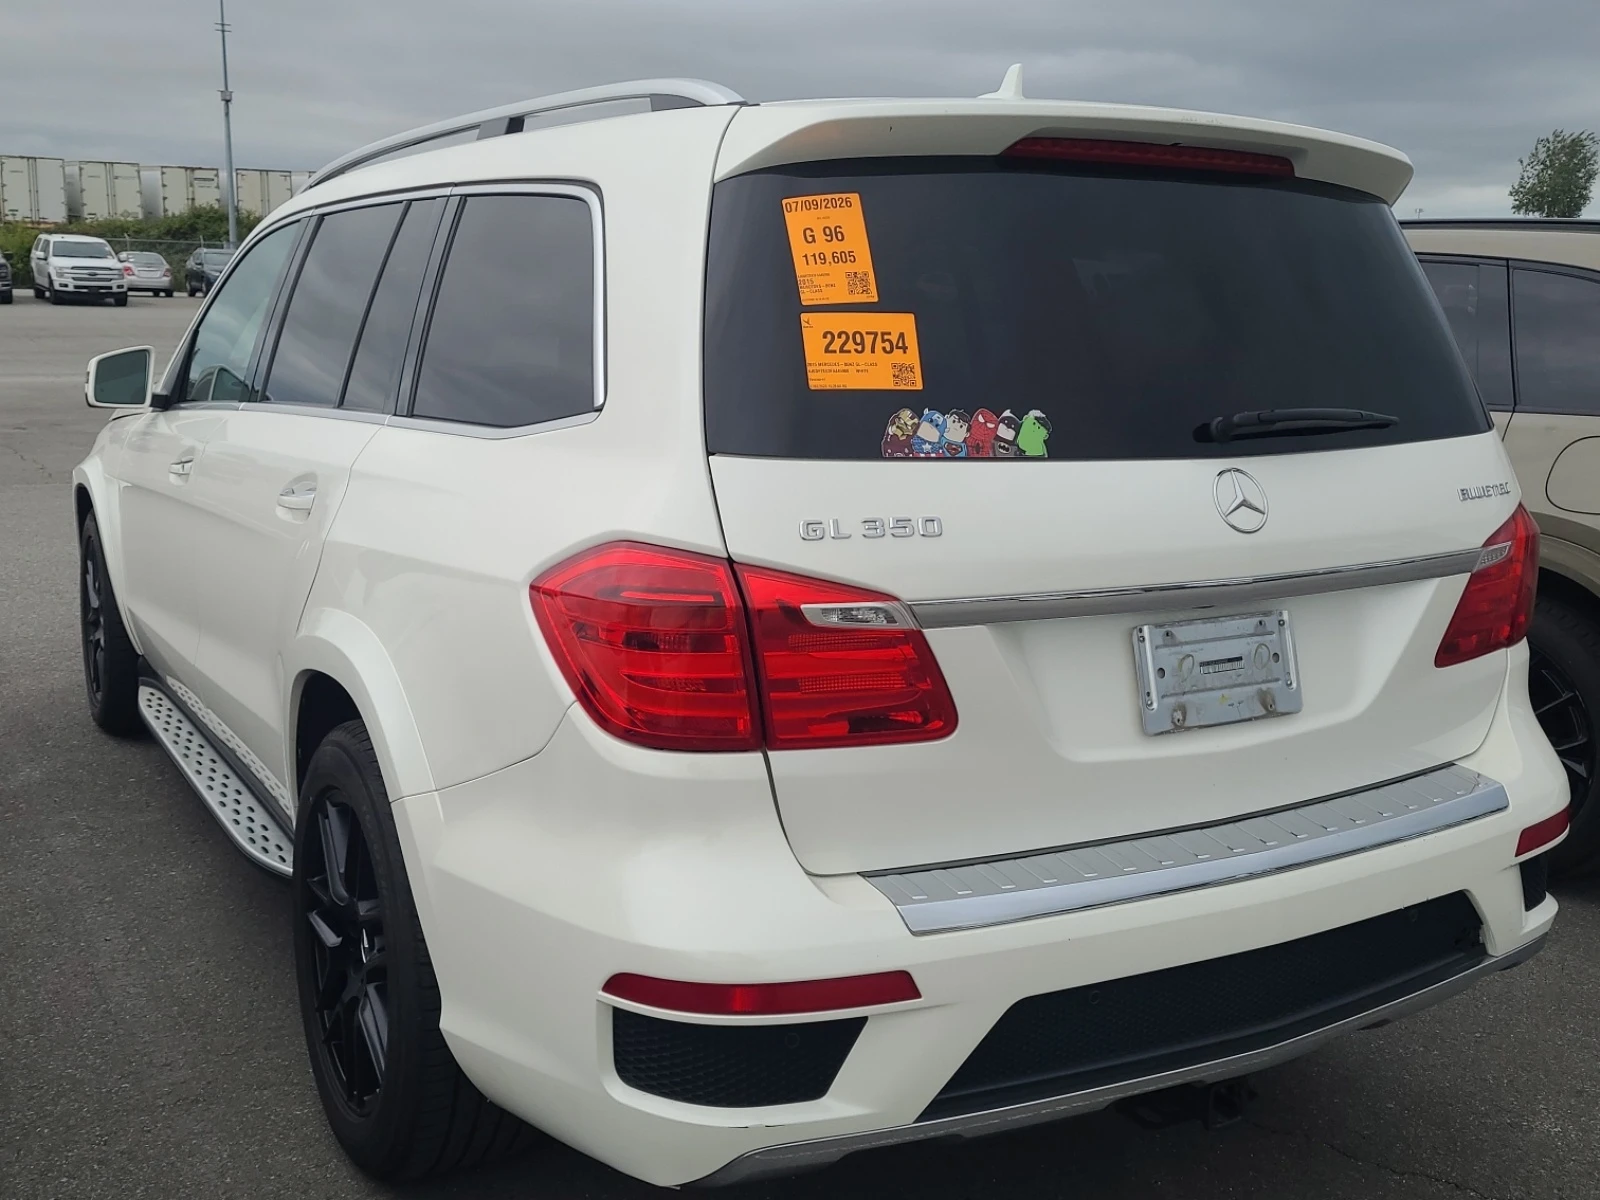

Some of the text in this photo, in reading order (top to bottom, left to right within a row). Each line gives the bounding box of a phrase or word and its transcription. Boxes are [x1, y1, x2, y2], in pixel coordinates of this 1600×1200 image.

[784, 196, 853, 213] 07/09/2026
[802, 224, 845, 244] G 96
[801, 250, 857, 267] 119,605
[822, 330, 909, 355] 229754
[1457, 481, 1511, 502] BLUETEC
[799, 515, 943, 541] GL 350
